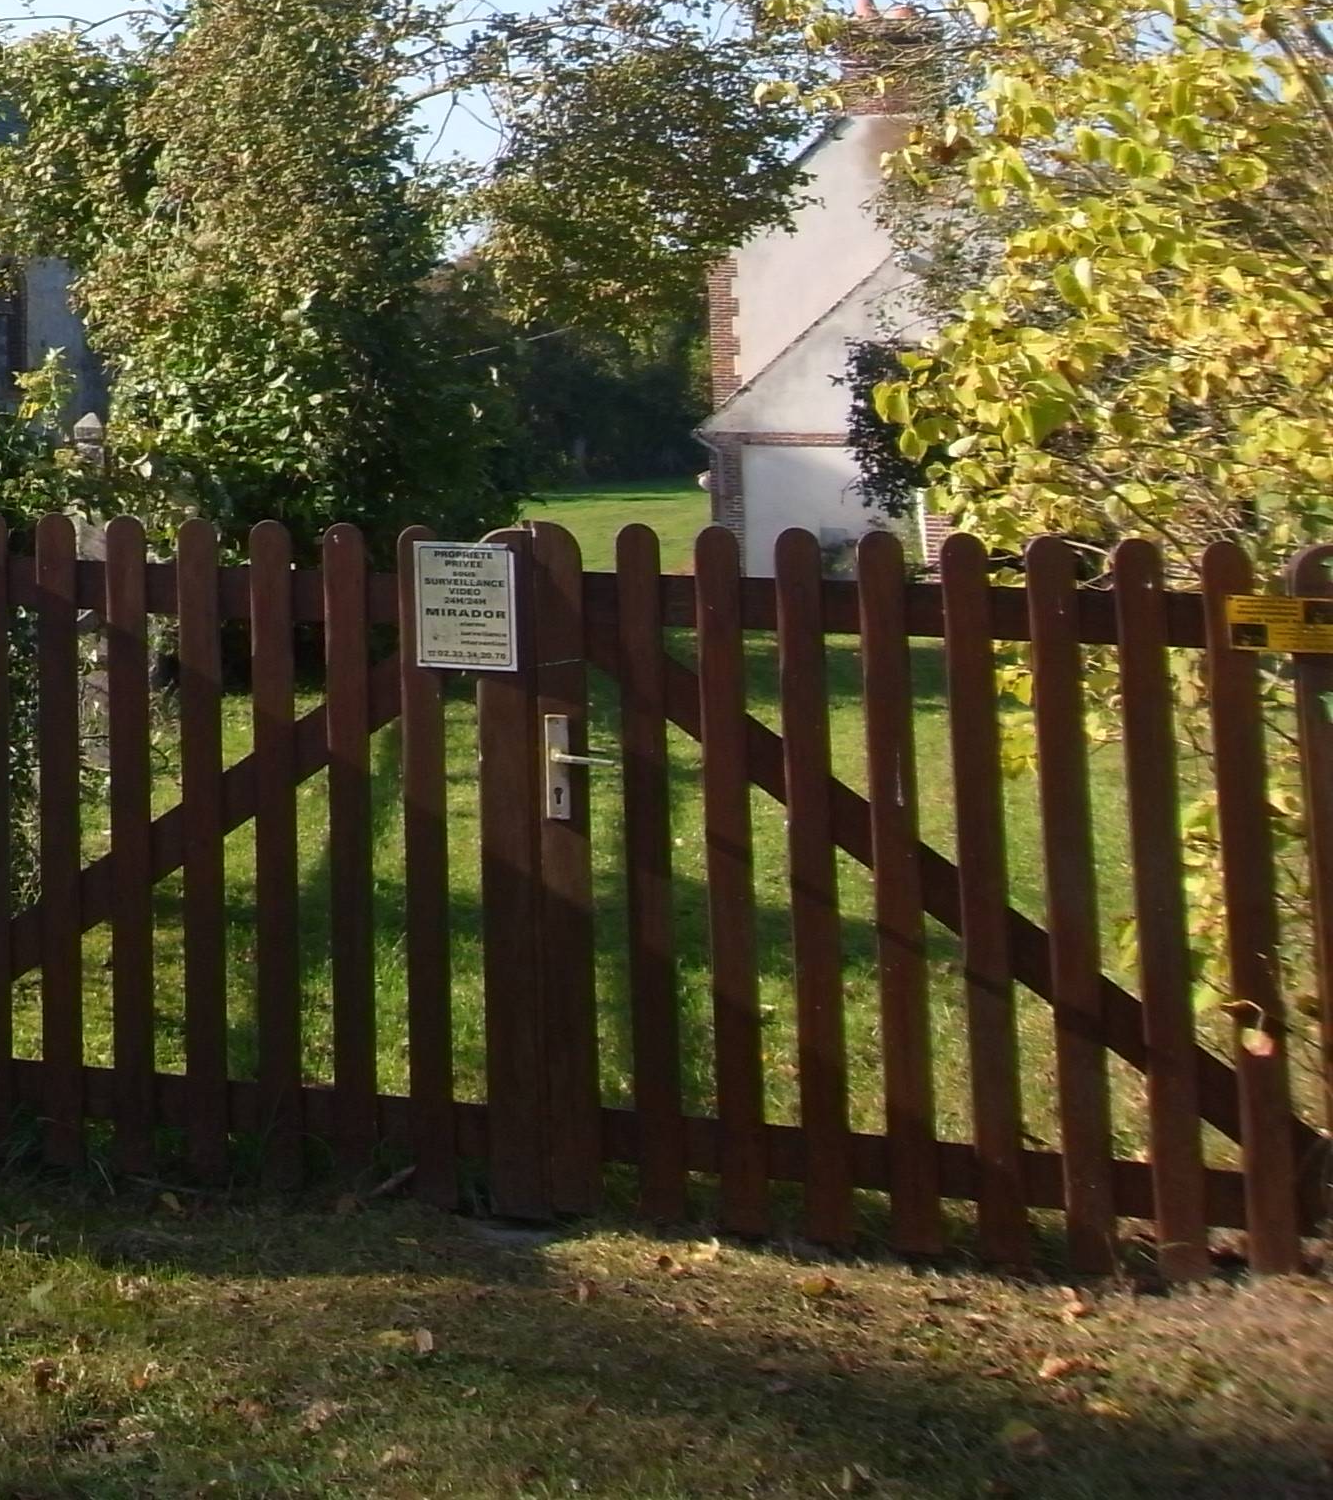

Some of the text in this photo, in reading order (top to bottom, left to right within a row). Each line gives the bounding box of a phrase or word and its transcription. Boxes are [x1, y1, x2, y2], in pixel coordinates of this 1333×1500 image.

[434, 550, 493, 559] PROPRIETE
[444, 560, 483, 568] PRIVEE
[424, 578, 505, 588] SURVEILLANCE
[449, 587, 481, 596] VIDEO
[425, 607, 506, 619] MIRADOR
